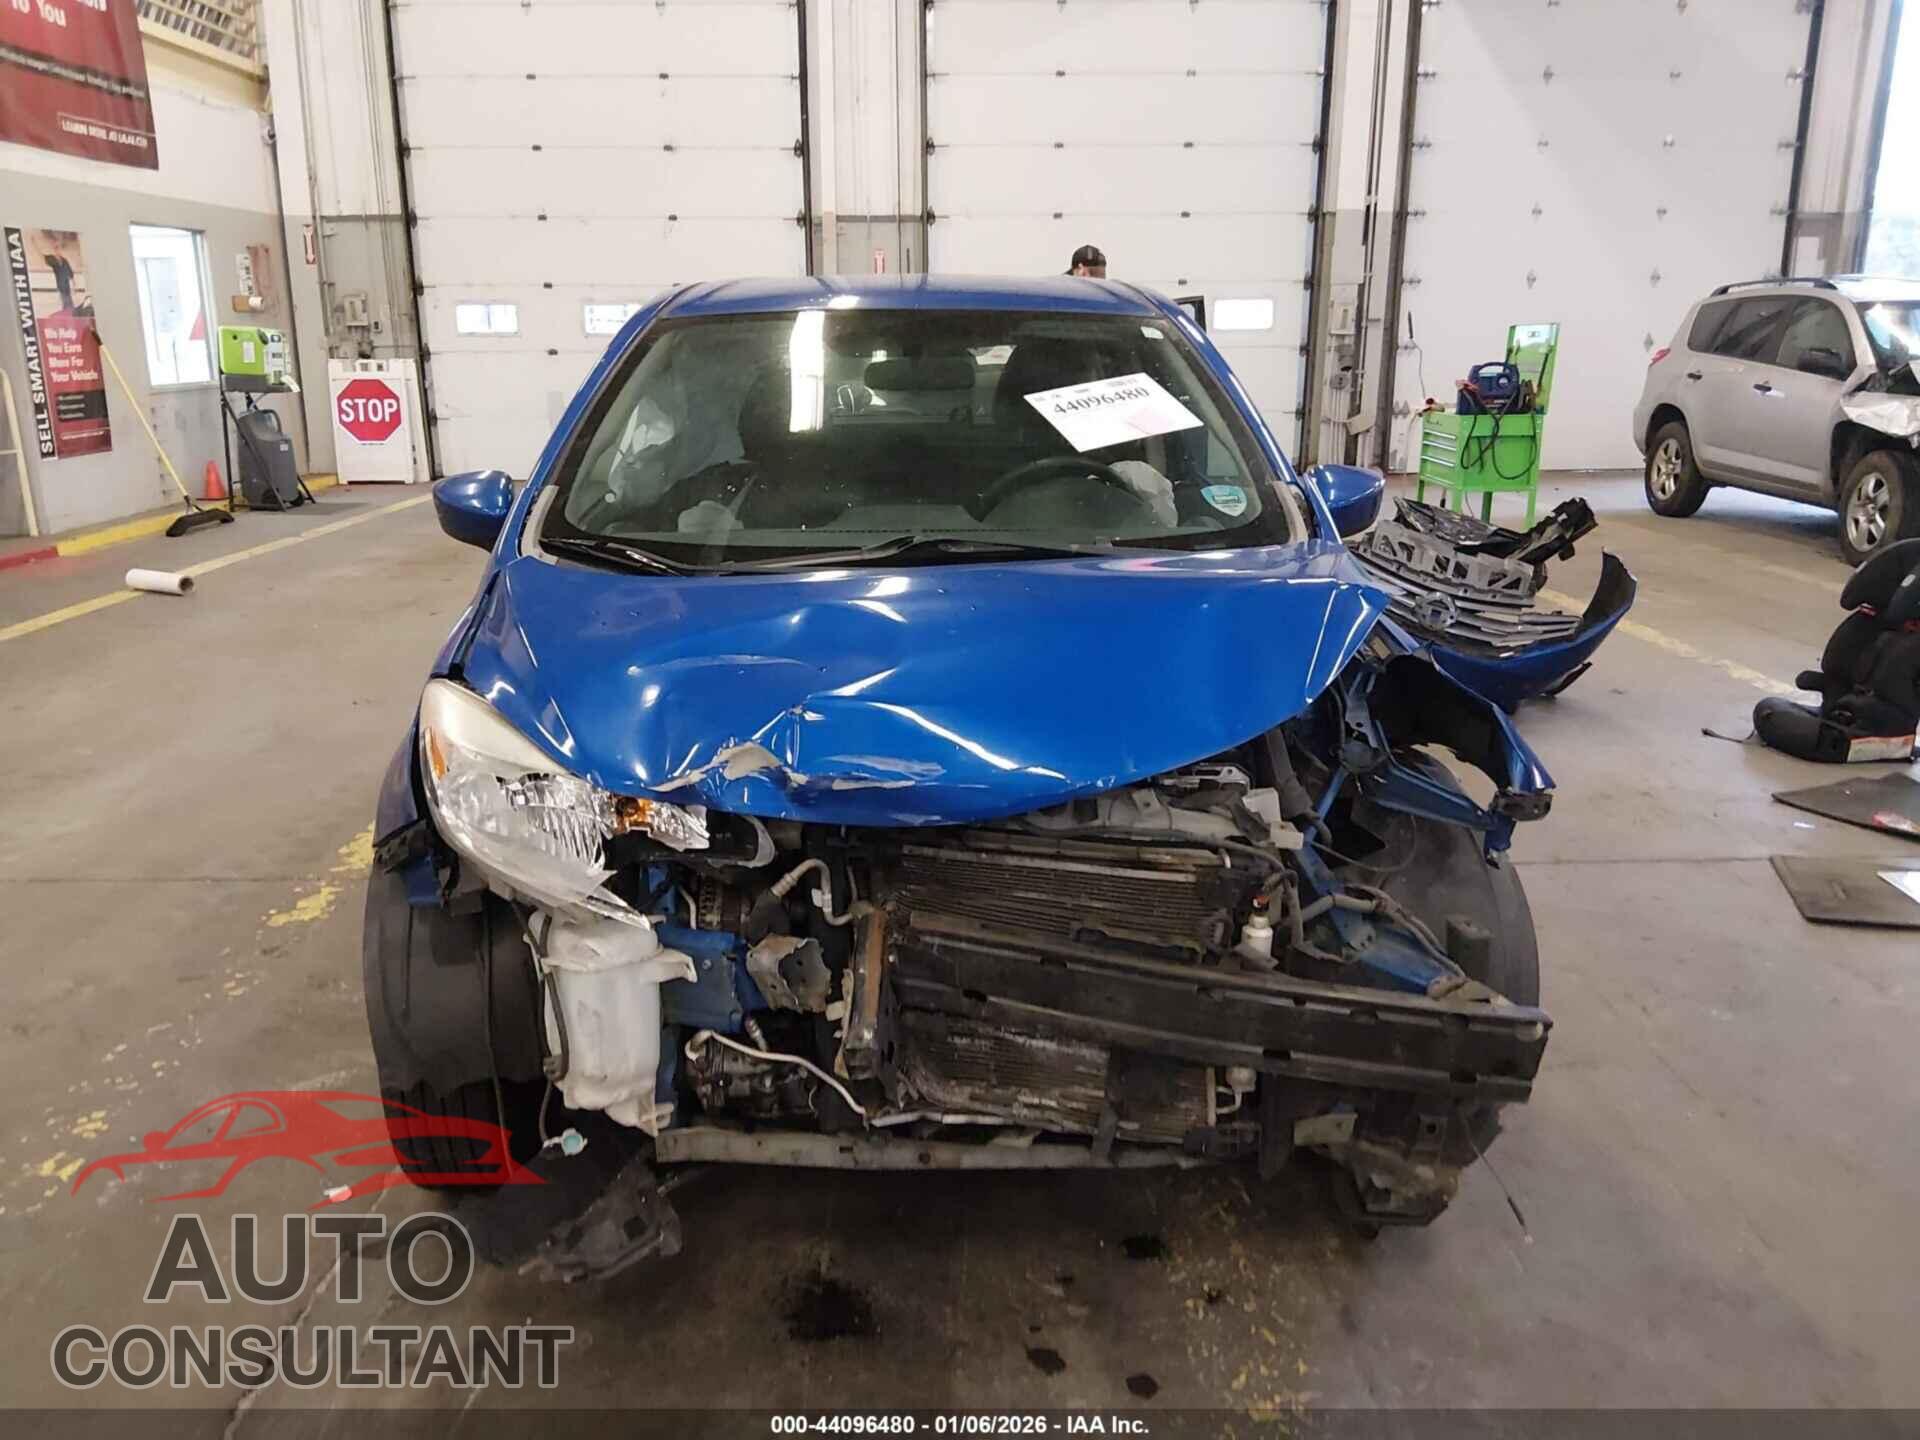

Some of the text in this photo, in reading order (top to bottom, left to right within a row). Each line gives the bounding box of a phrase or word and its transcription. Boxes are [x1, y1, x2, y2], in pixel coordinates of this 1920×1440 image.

[36, 0, 67, 28] You
[8, 232, 54, 454] SELL SMART WITH IAA
[340, 398, 398, 423] STOP
[1053, 386, 1150, 415] 44096480
